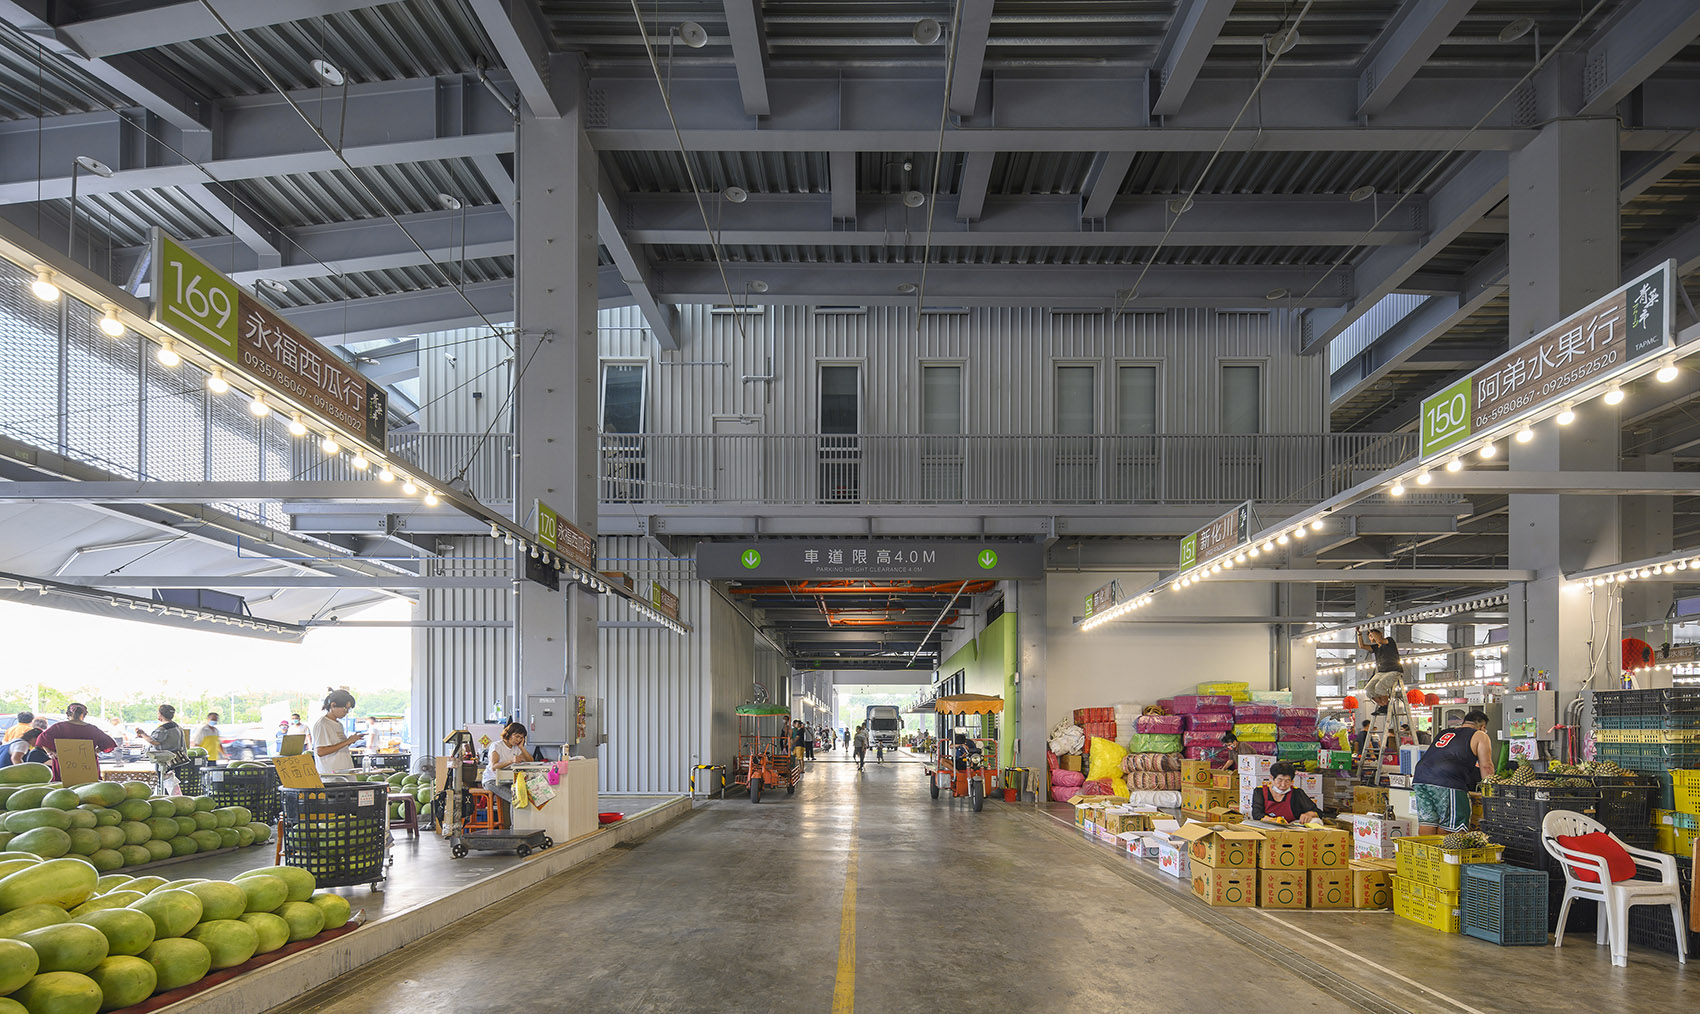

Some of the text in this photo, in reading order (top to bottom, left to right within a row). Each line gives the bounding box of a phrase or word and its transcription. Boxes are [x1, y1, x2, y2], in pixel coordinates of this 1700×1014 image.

[170, 261, 232, 329] 169
[245, 311, 363, 412] 永福西瓜行
[1478, 306, 1620, 409] 阿弟水果行
[244, 351, 308, 399] 0935785067
[313, 394, 362, 432] 0918361022
[1427, 393, 1466, 437] 150
[1476, 350, 1617, 427] 06-5980867 0925552520
[540, 512, 556, 538] 170
[1182, 540, 1196, 561] 151
[1656, 648, 1692, 660] 兆水果行
[1435, 732, 1456, 748] 9
